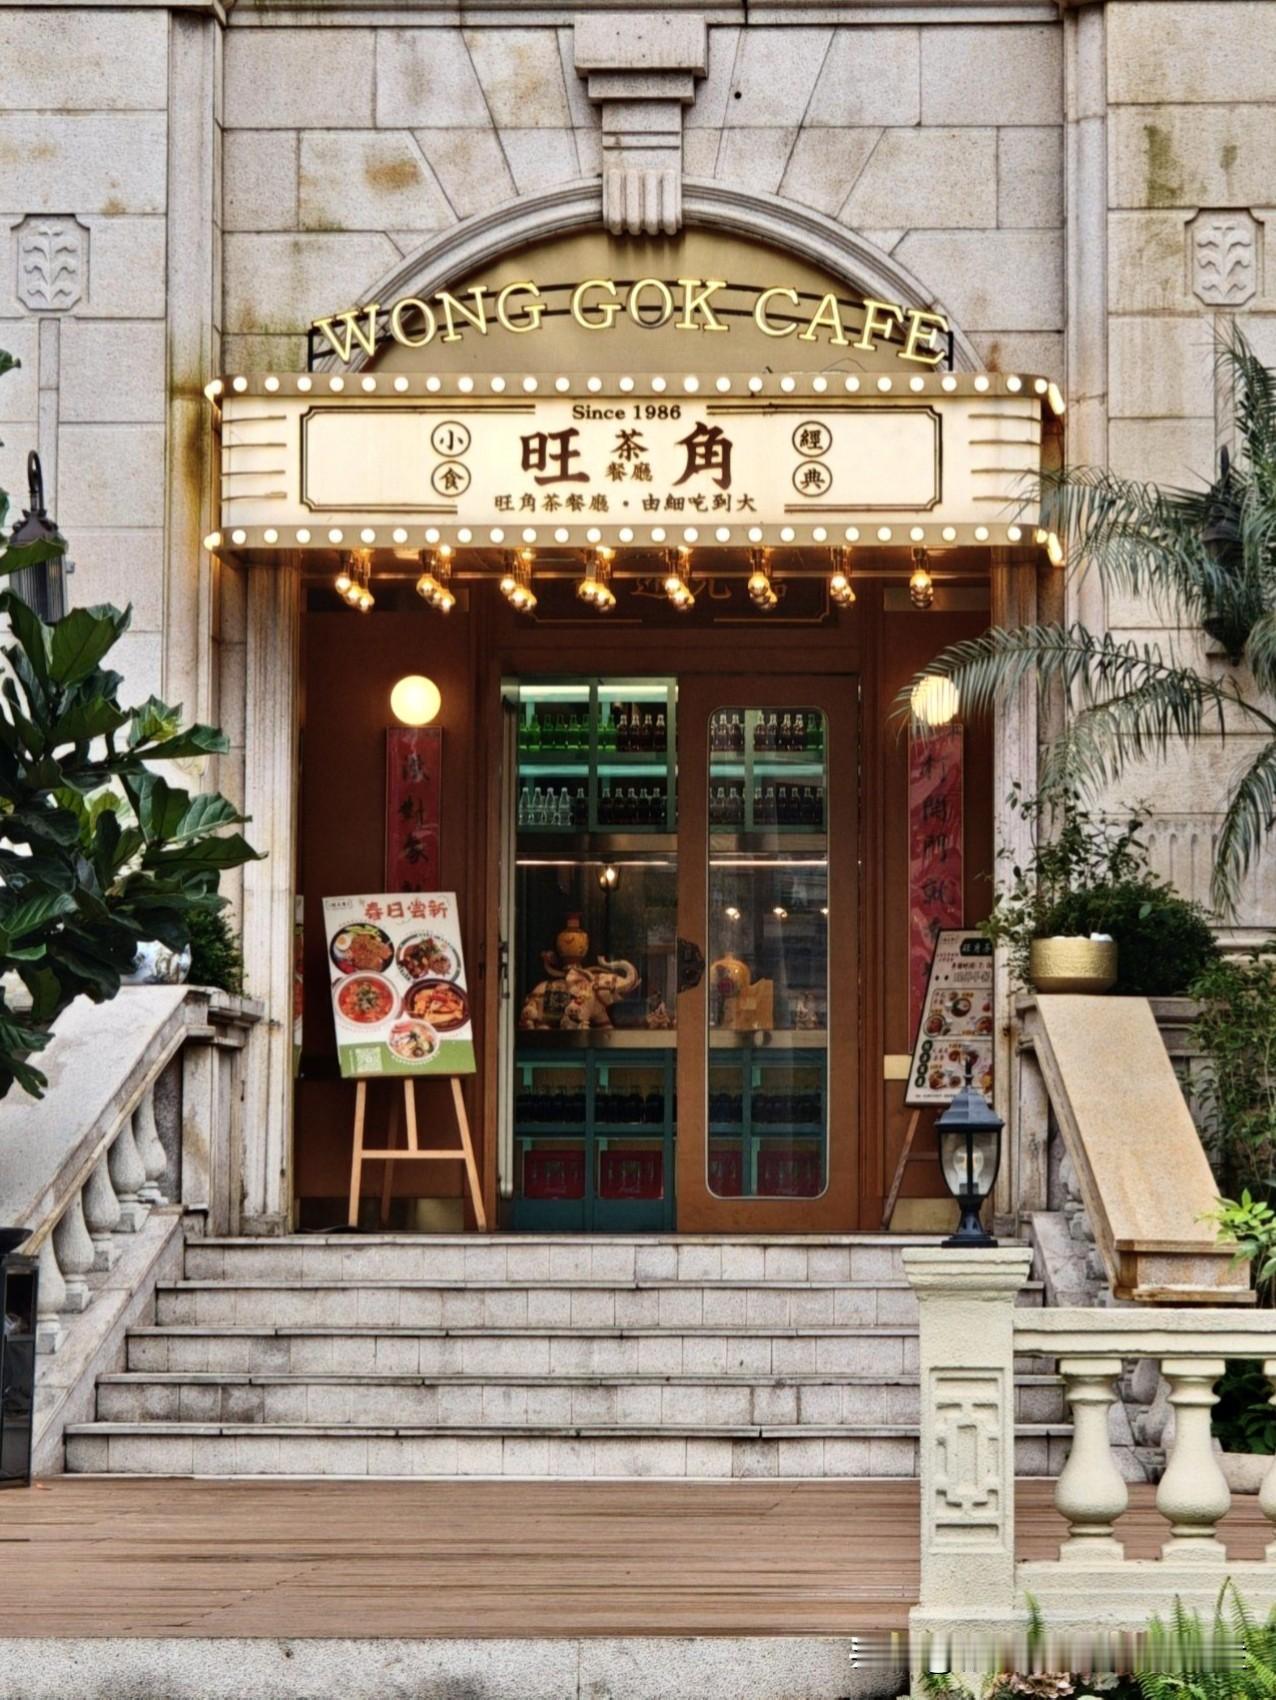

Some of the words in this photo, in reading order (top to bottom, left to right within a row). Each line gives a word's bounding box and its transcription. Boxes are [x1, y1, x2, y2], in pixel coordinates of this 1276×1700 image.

[312, 281, 547, 363] WONG
[571, 279, 729, 332] GOK
[752, 287, 950, 365] CAFE
[572, 404, 626, 420] Since
[633, 405, 682, 420] 1986
[520, 427, 591, 486] 旺
[611, 428, 649, 462] 茶
[672, 421, 734, 490] 角
